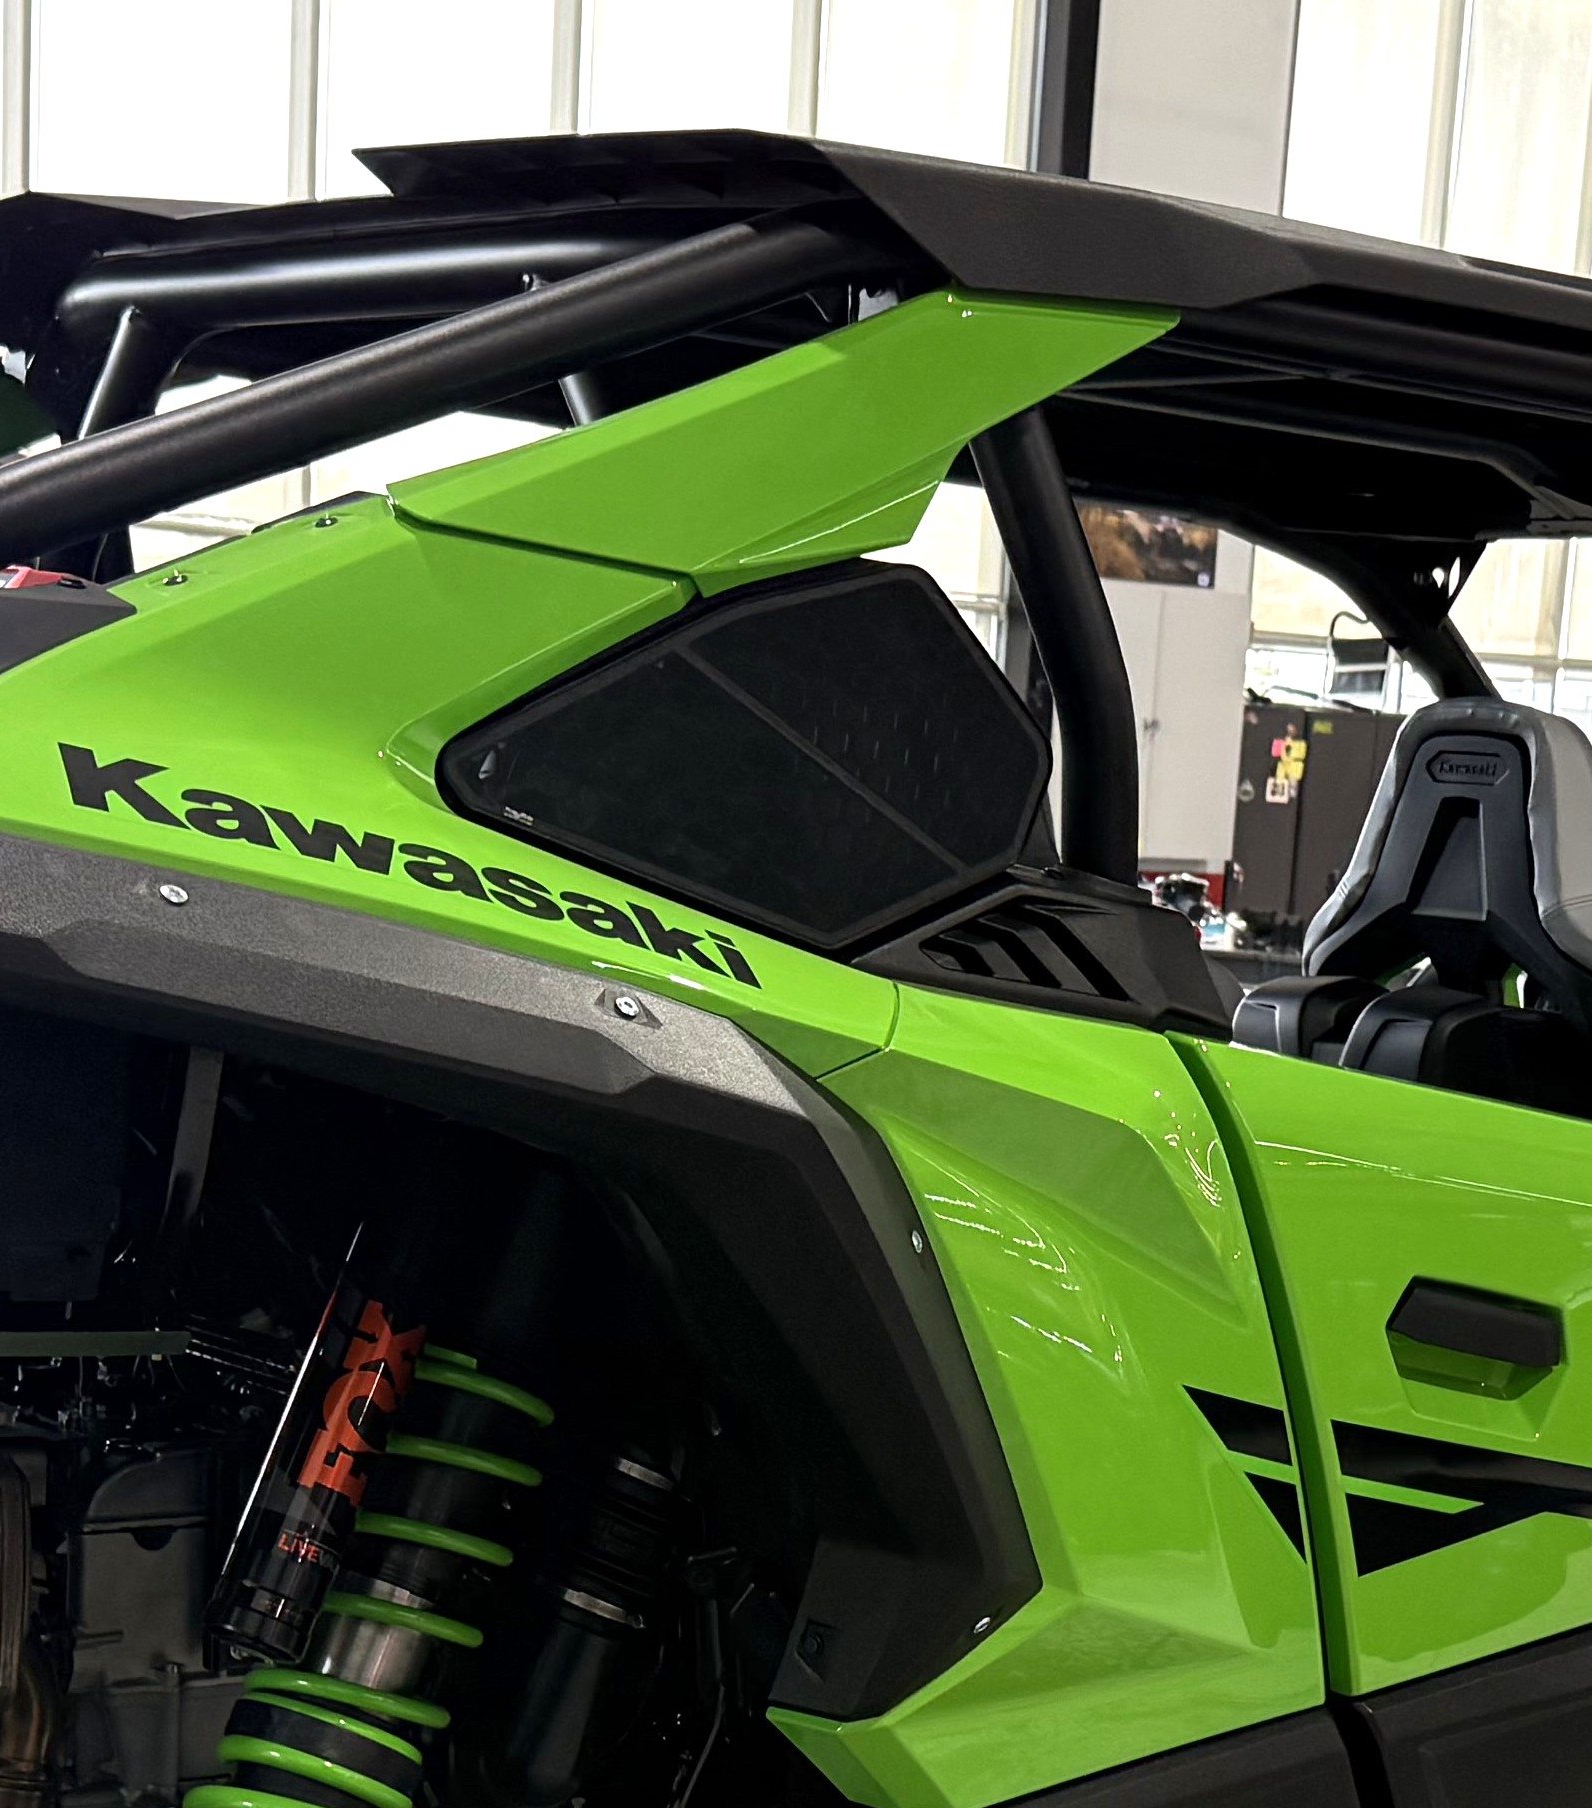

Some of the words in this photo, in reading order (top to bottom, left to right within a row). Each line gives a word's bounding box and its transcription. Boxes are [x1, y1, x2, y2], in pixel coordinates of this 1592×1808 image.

[58, 742, 762, 989] Kawasaki
[296, 1299, 427, 1508] FOX
[277, 1533, 320, 1564] LIVE
